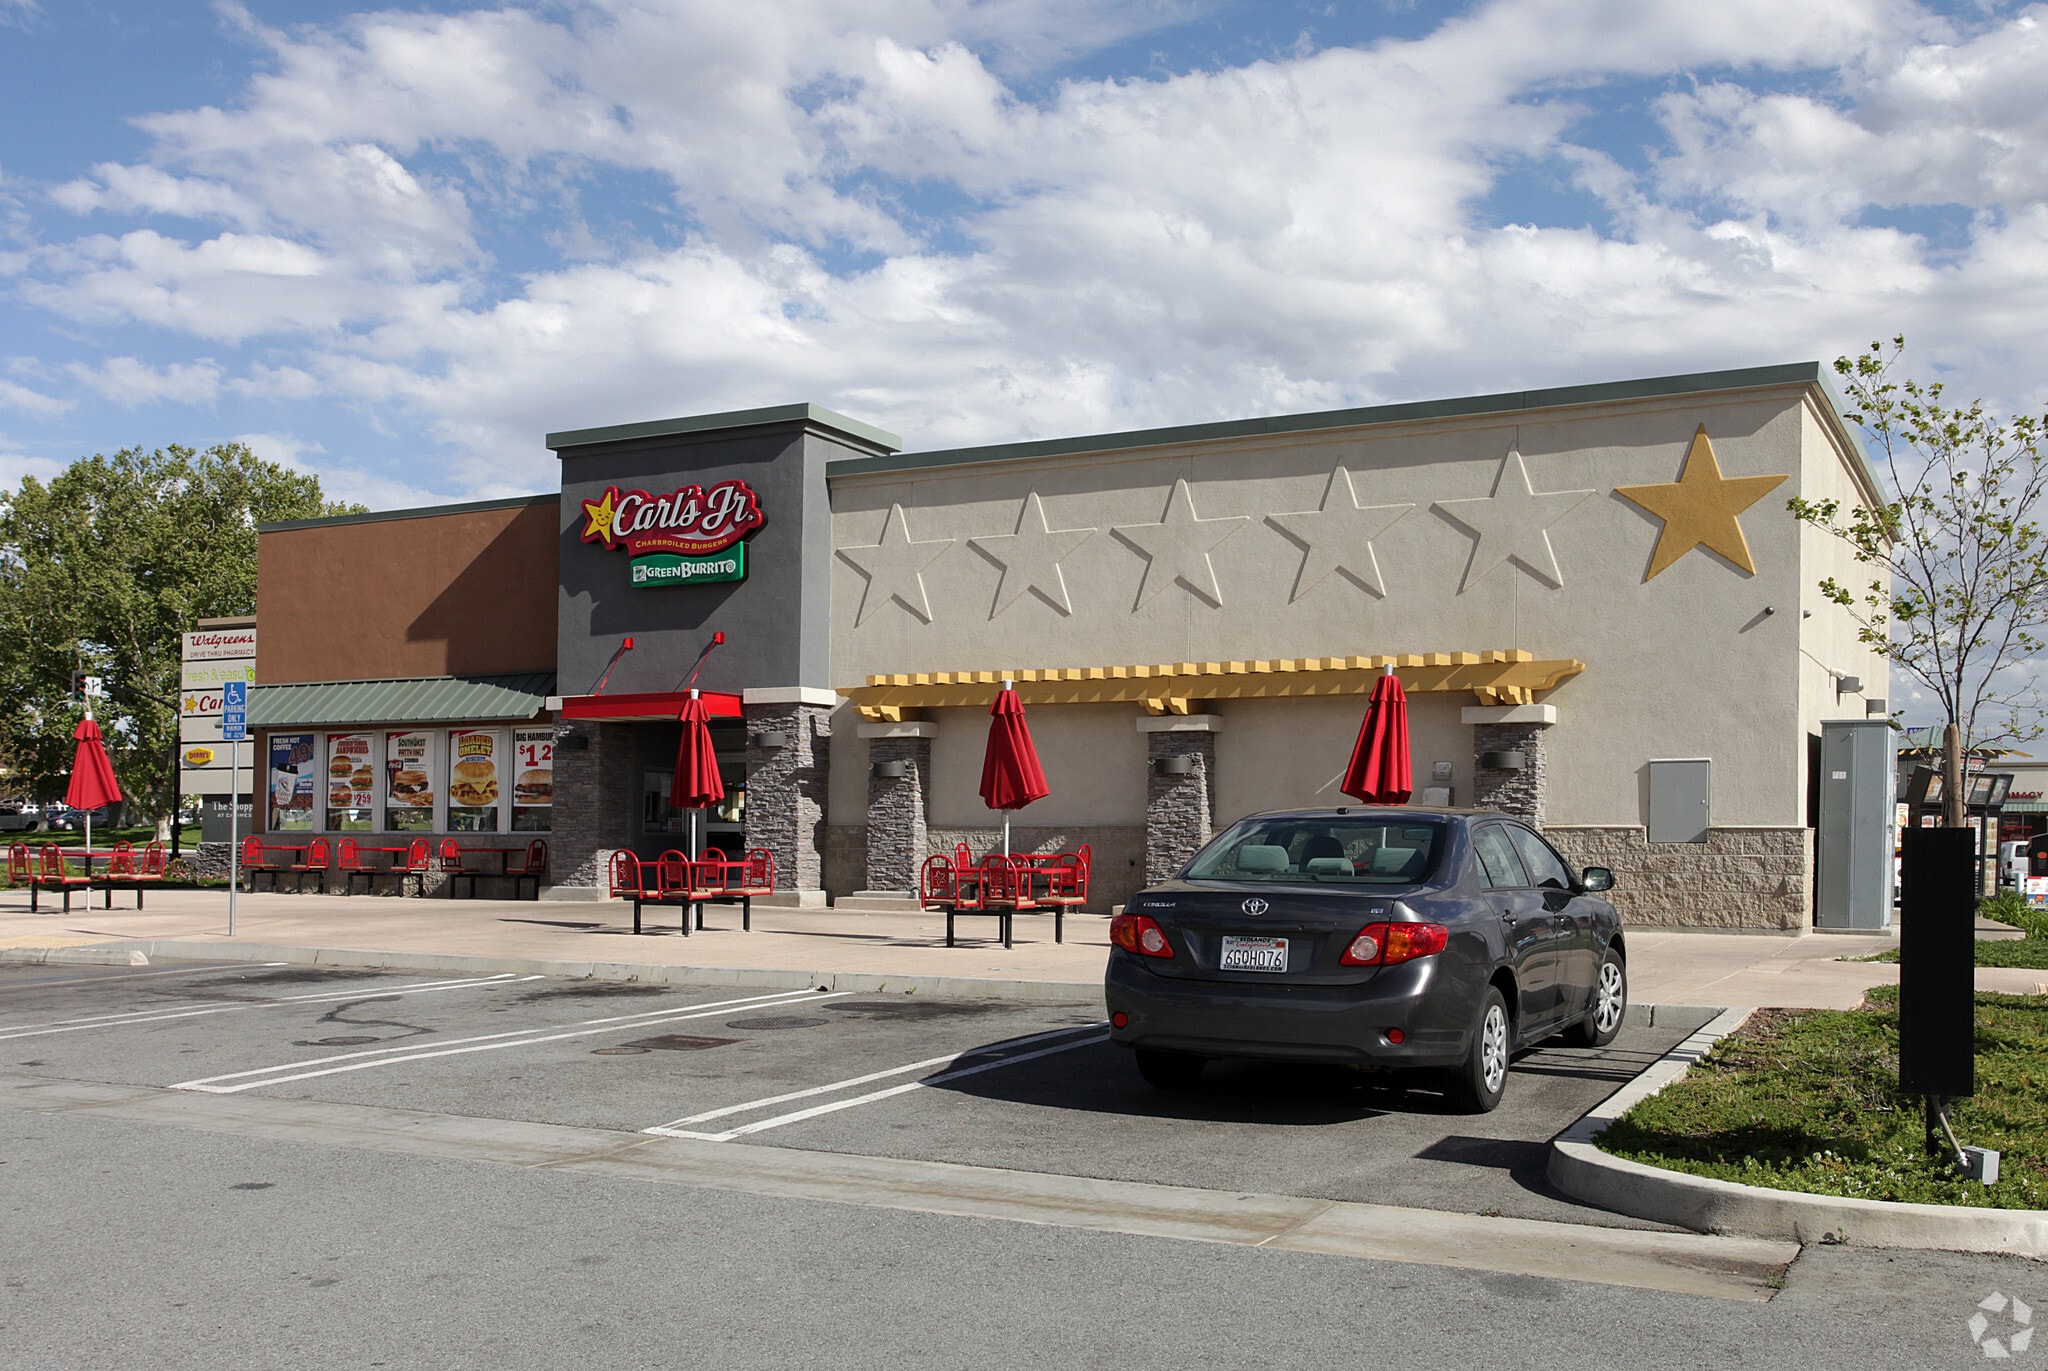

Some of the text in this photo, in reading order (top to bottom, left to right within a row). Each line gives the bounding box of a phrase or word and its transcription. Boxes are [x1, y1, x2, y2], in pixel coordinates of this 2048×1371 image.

[612, 486, 754, 536] Carl's Jr.
[635, 538, 728, 550] CHARBROILED BURGERS
[190, 634, 255, 649] Walgreens
[185, 668, 209, 682] fresh
[199, 695, 224, 712] Car
[225, 704, 245, 713] PARKING
[228, 714, 241, 723] ONLY
[459, 735, 492, 747] LOADED
[515, 732, 526, 742] BIG
[189, 751, 209, 760] Denny's
[336, 746, 369, 754] SANDWICHES
[459, 745, 492, 757] OMELET
[519, 744, 553, 767] $1.2
[212, 801, 227, 811] The
